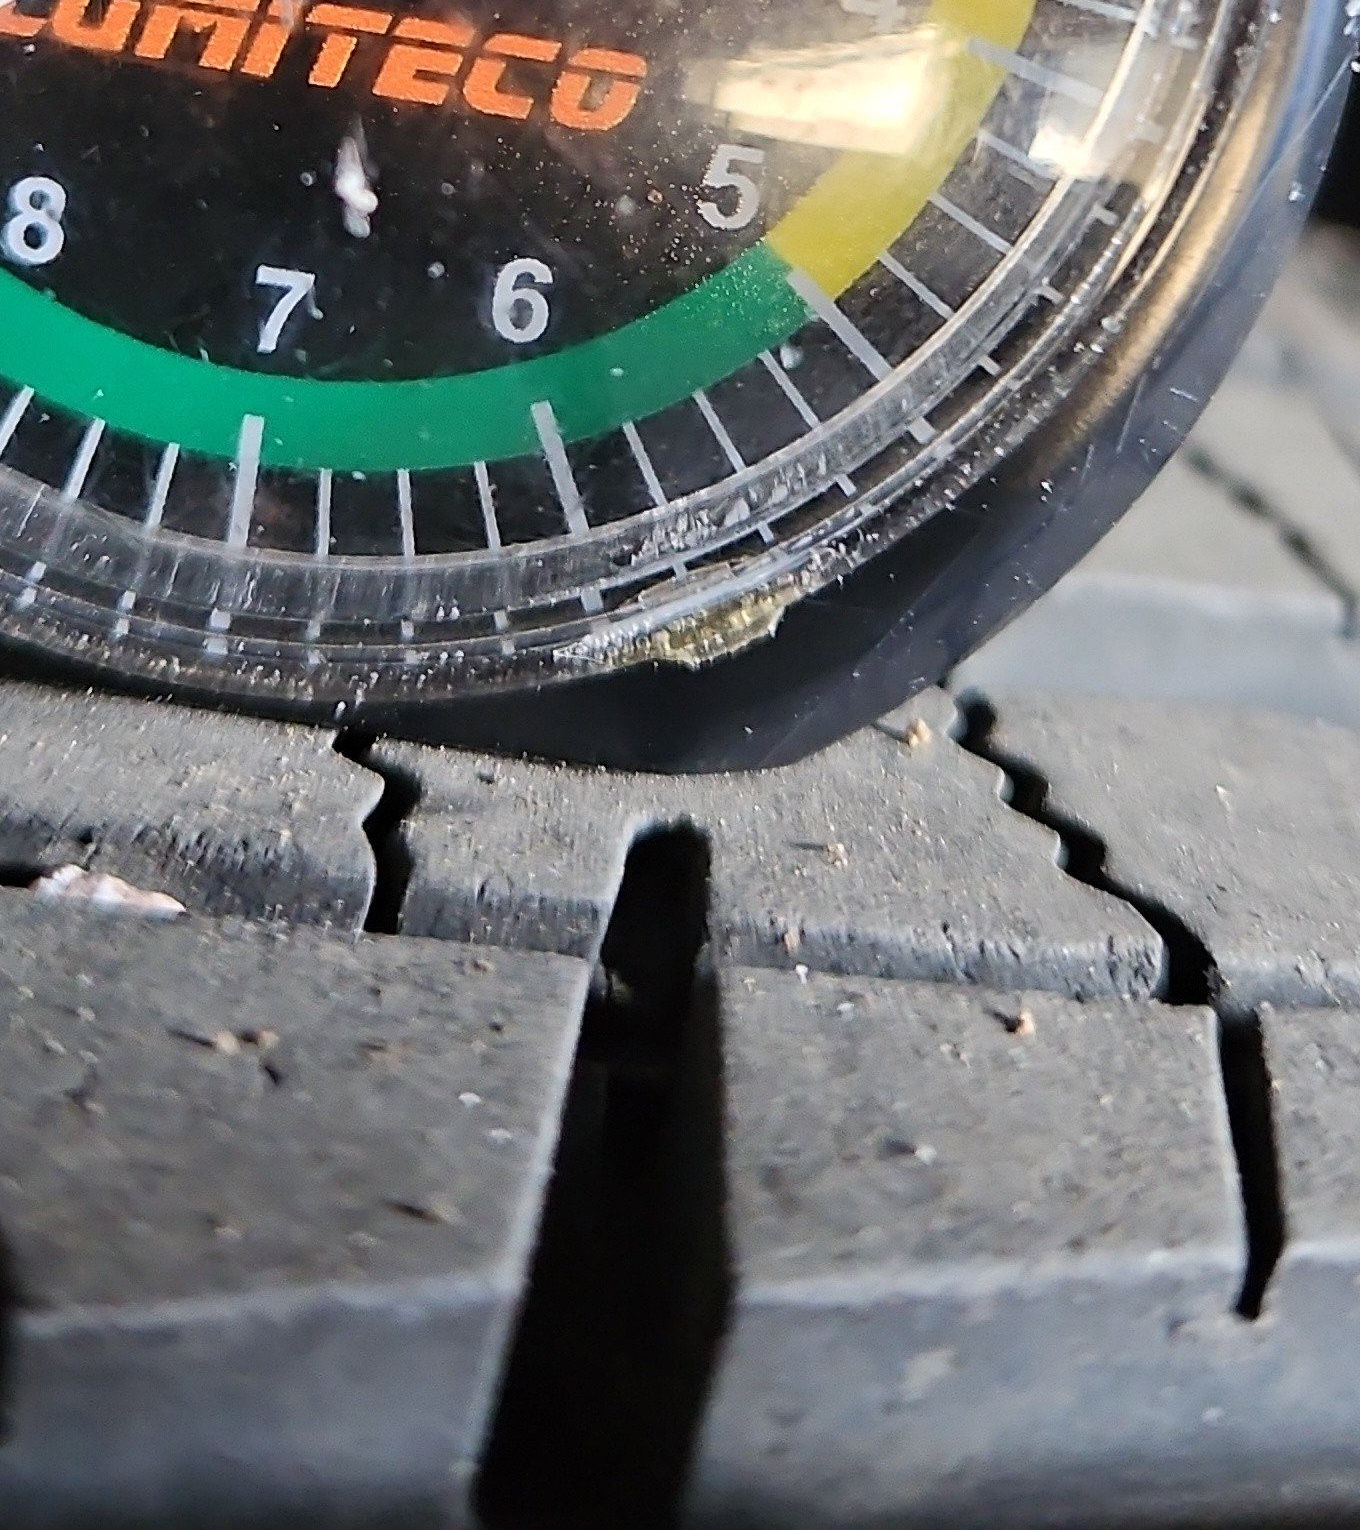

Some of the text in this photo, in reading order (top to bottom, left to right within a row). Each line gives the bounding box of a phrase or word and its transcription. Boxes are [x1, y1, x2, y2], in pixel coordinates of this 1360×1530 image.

[1, 176, 67, 266] 8
[696, 143, 765, 230] 5
[255, 264, 317, 354] 7
[491, 257, 554, 342] 6
